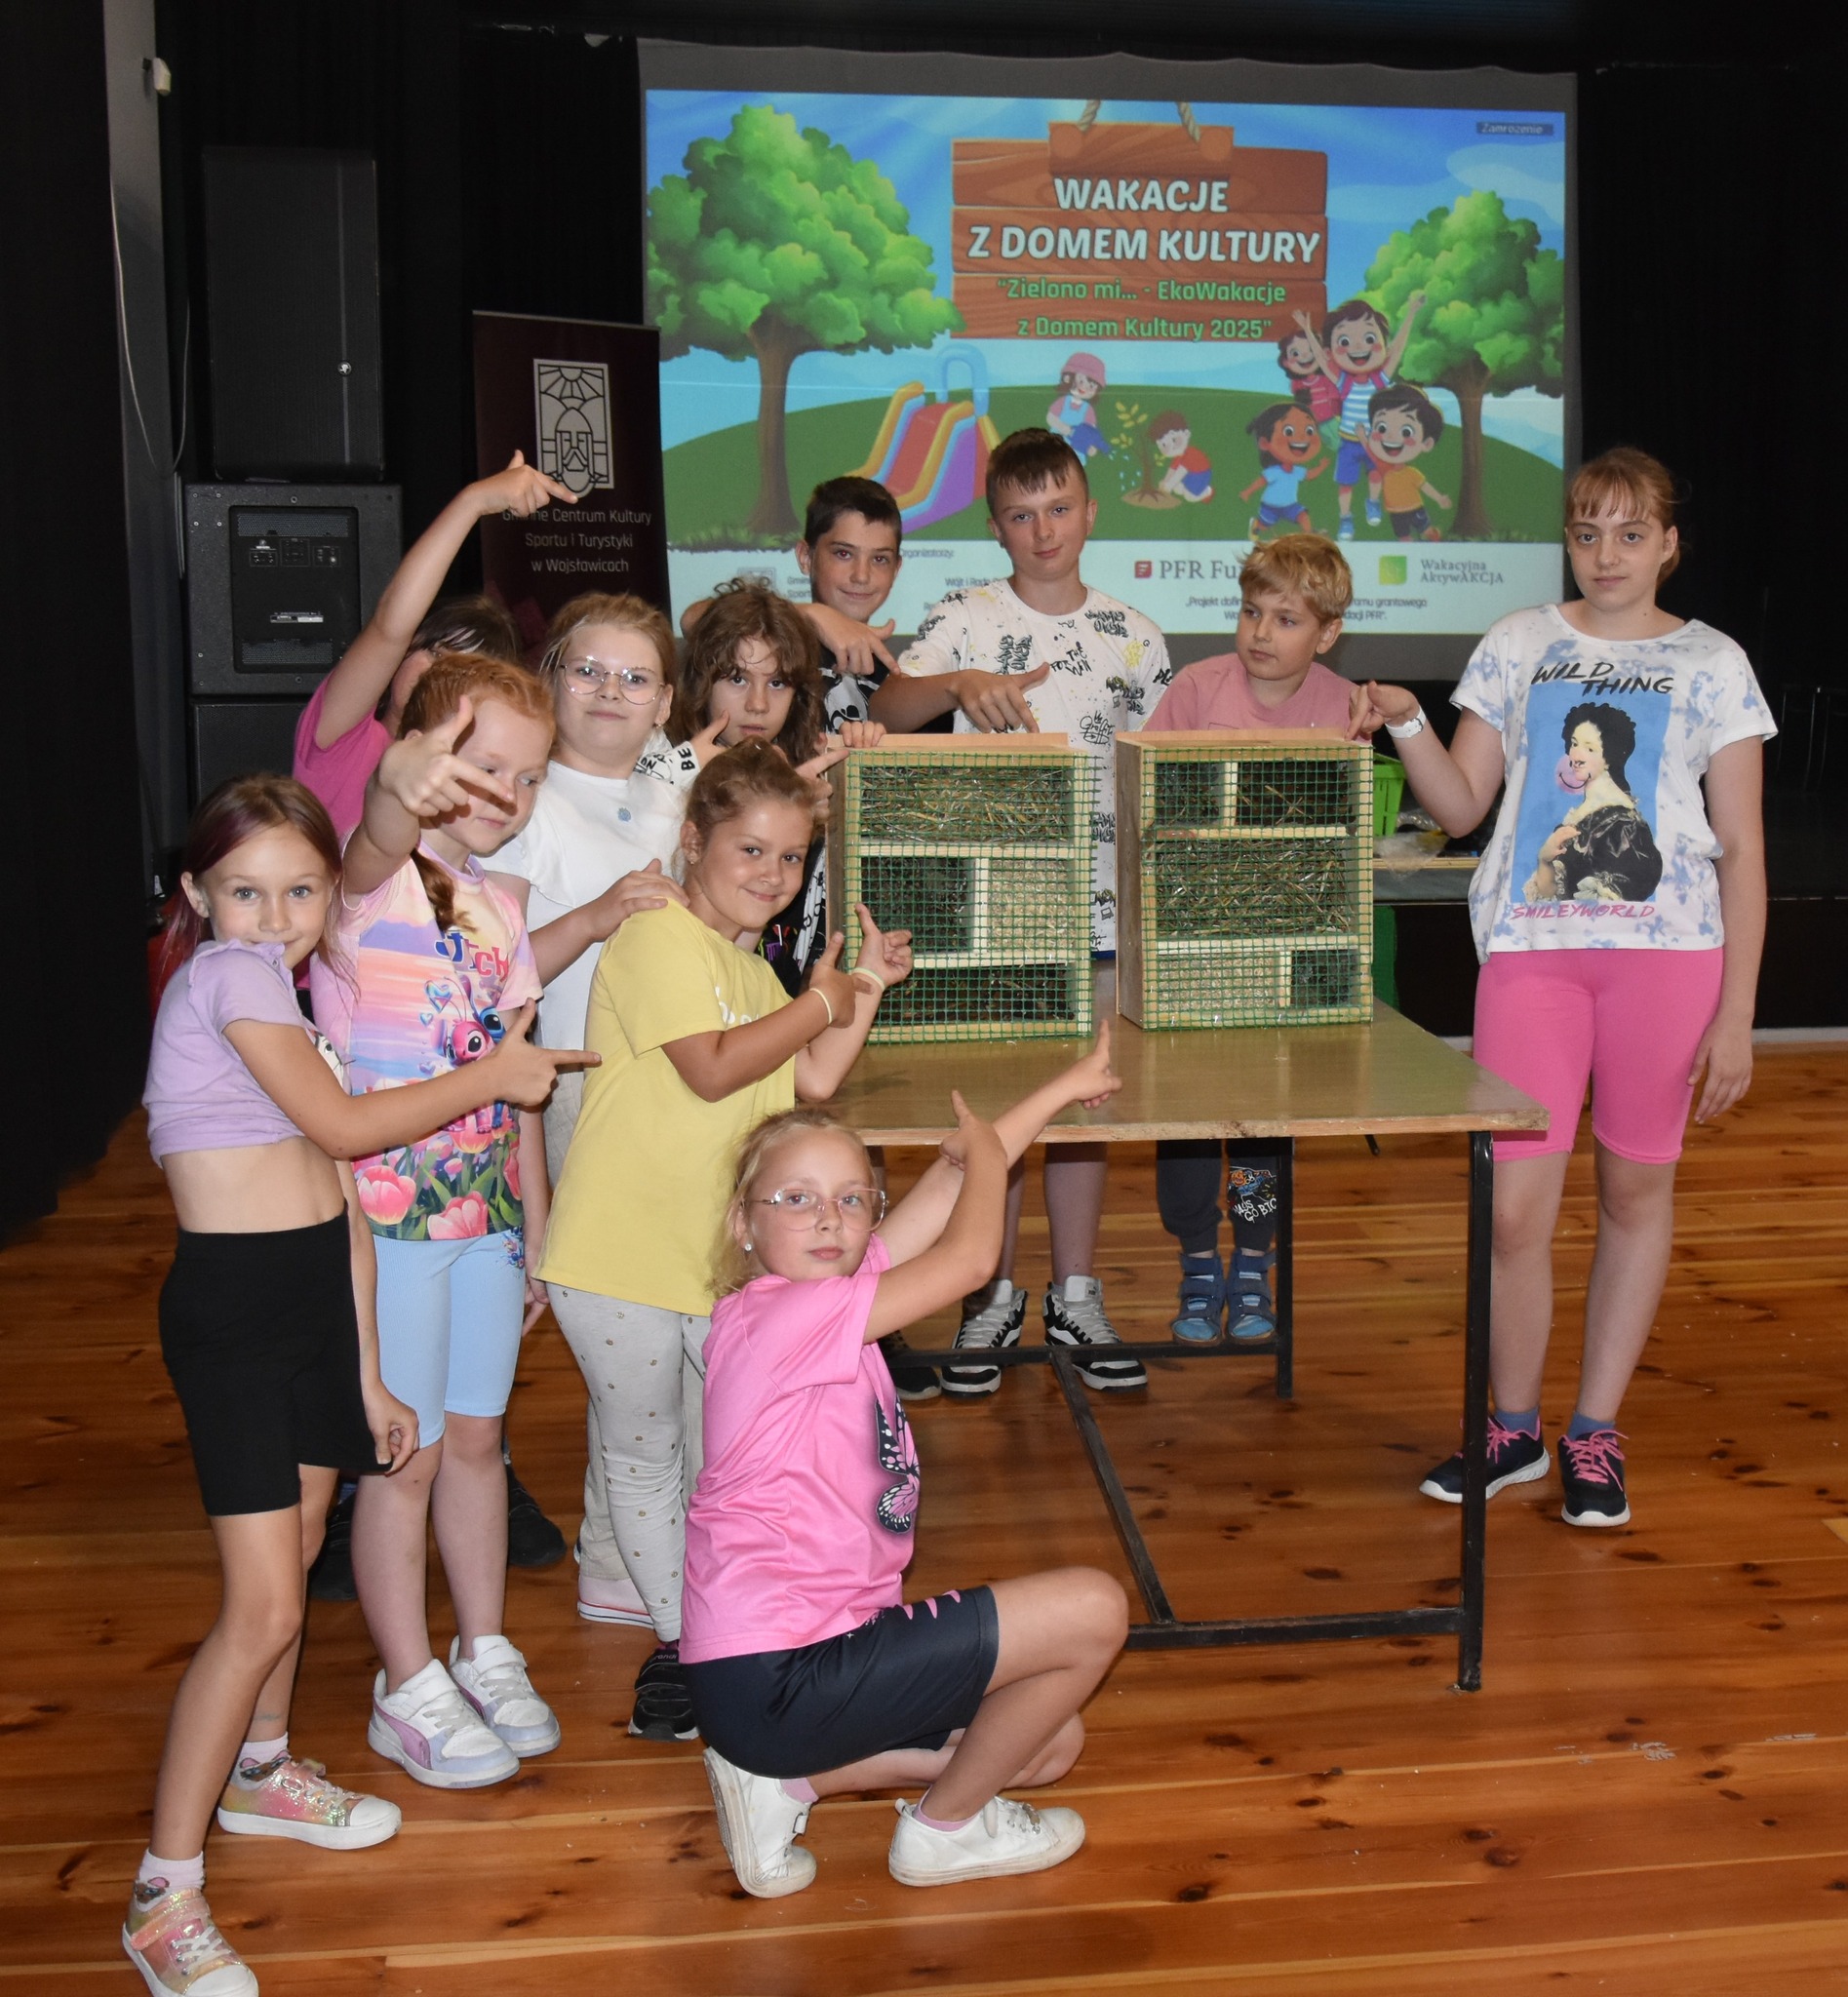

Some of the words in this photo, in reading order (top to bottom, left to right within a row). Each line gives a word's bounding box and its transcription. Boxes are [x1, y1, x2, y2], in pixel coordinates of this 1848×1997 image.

[1054, 177, 1229, 213] WAKACJE
[968, 226, 991, 258] Z
[1001, 227, 1147, 261] DOMEM
[1159, 231, 1320, 264] KULTURY
[1093, 279, 1138, 300] mi...
[1158, 281, 1286, 304] EkoWakacje
[1036, 317, 1118, 337] Domem
[1125, 318, 1204, 341] Kultury
[552, 508, 606, 523] Centrum
[609, 510, 652, 526] Kultury
[526, 533, 568, 547] Sportu
[578, 533, 633, 550] Turystyki
[531, 561, 542, 571] w
[546, 559, 629, 573] Wojsławicach
[1160, 561, 1204, 579] PFR
[1210, 561, 1241, 579] Fu
[1421, 559, 1486, 573] Wakacyjna
[1420, 571, 1504, 585] AktywAKCJA
[1531, 662, 1614, 685] WILD
[1581, 677, 1674, 697] THING
[1512, 903, 1656, 920] SMILEYWORLD
